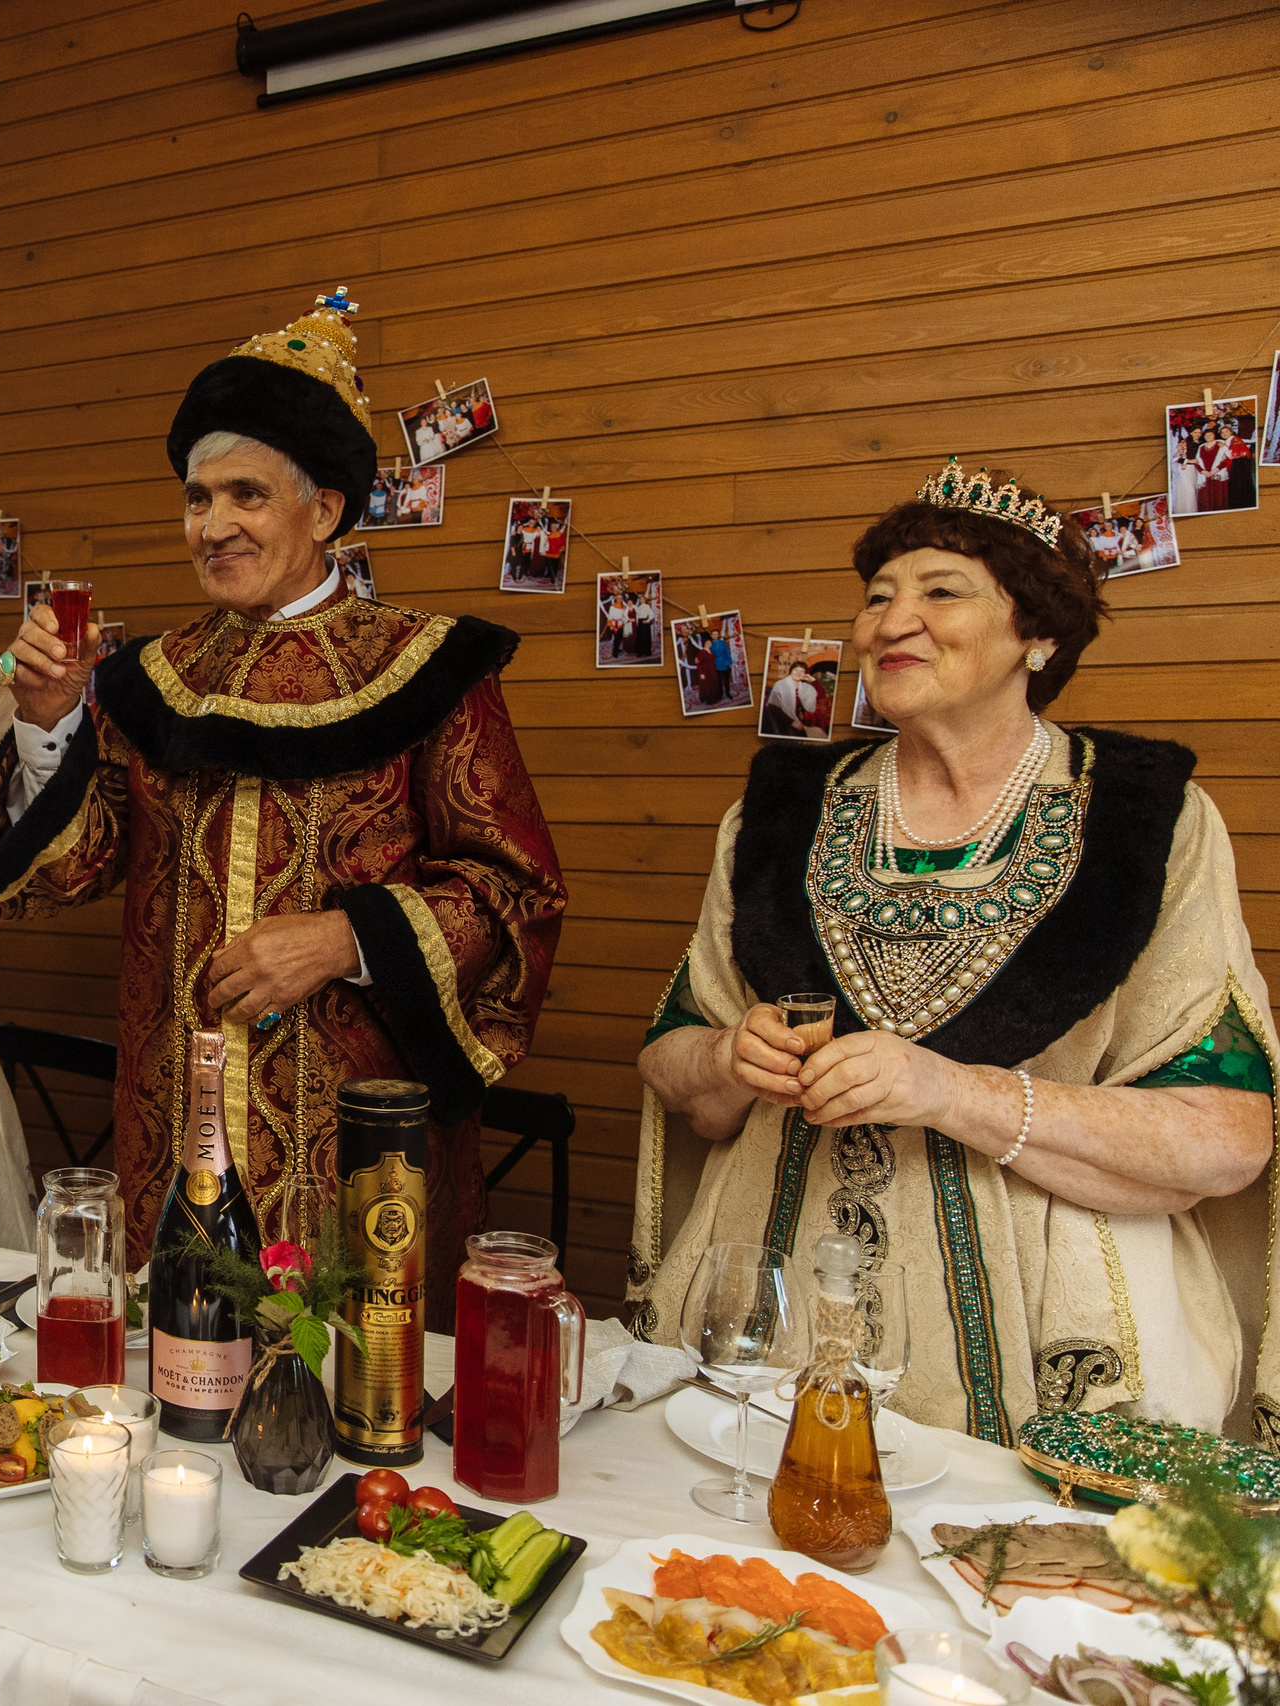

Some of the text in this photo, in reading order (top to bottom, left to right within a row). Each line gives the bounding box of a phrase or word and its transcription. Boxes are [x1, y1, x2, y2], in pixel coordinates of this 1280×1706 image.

[197, 1085, 217, 1161] MOËT
[372, 1311, 407, 1323] Gold
[169, 1348, 229, 1360] CHAMPAGNE
[157, 1365, 181, 1382] MOËT
[182, 1374, 189, 1384] &
[190, 1374, 244, 1387] CHANDON
[166, 1380, 186, 1391] ROSÉ
